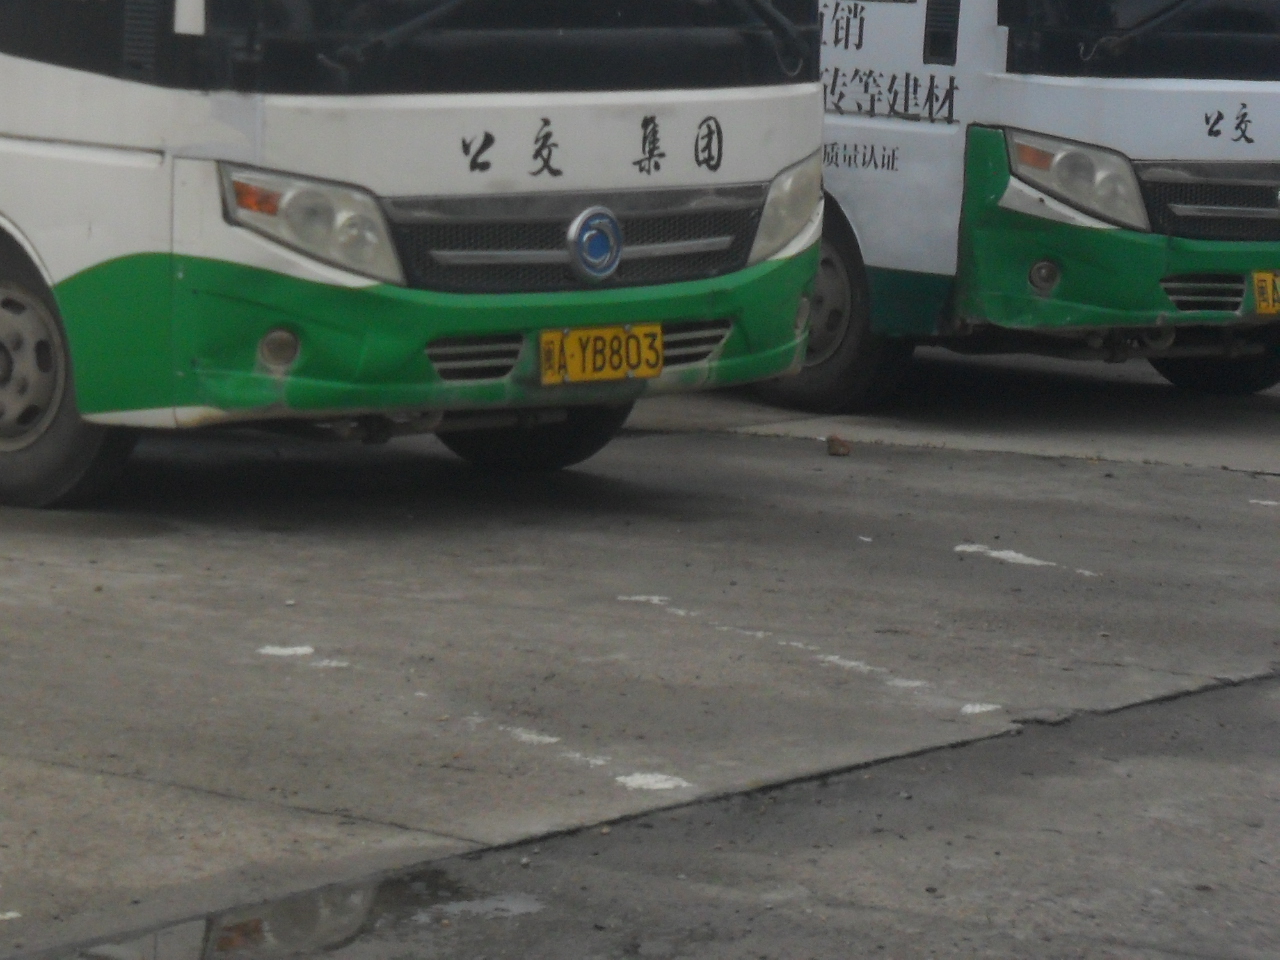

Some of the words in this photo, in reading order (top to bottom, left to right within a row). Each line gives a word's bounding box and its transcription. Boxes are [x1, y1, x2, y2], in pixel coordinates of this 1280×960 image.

[820, 2, 866, 50] 销
[1204, 103, 1254, 144] 公交
[822, 142, 899, 171] 质量认证
